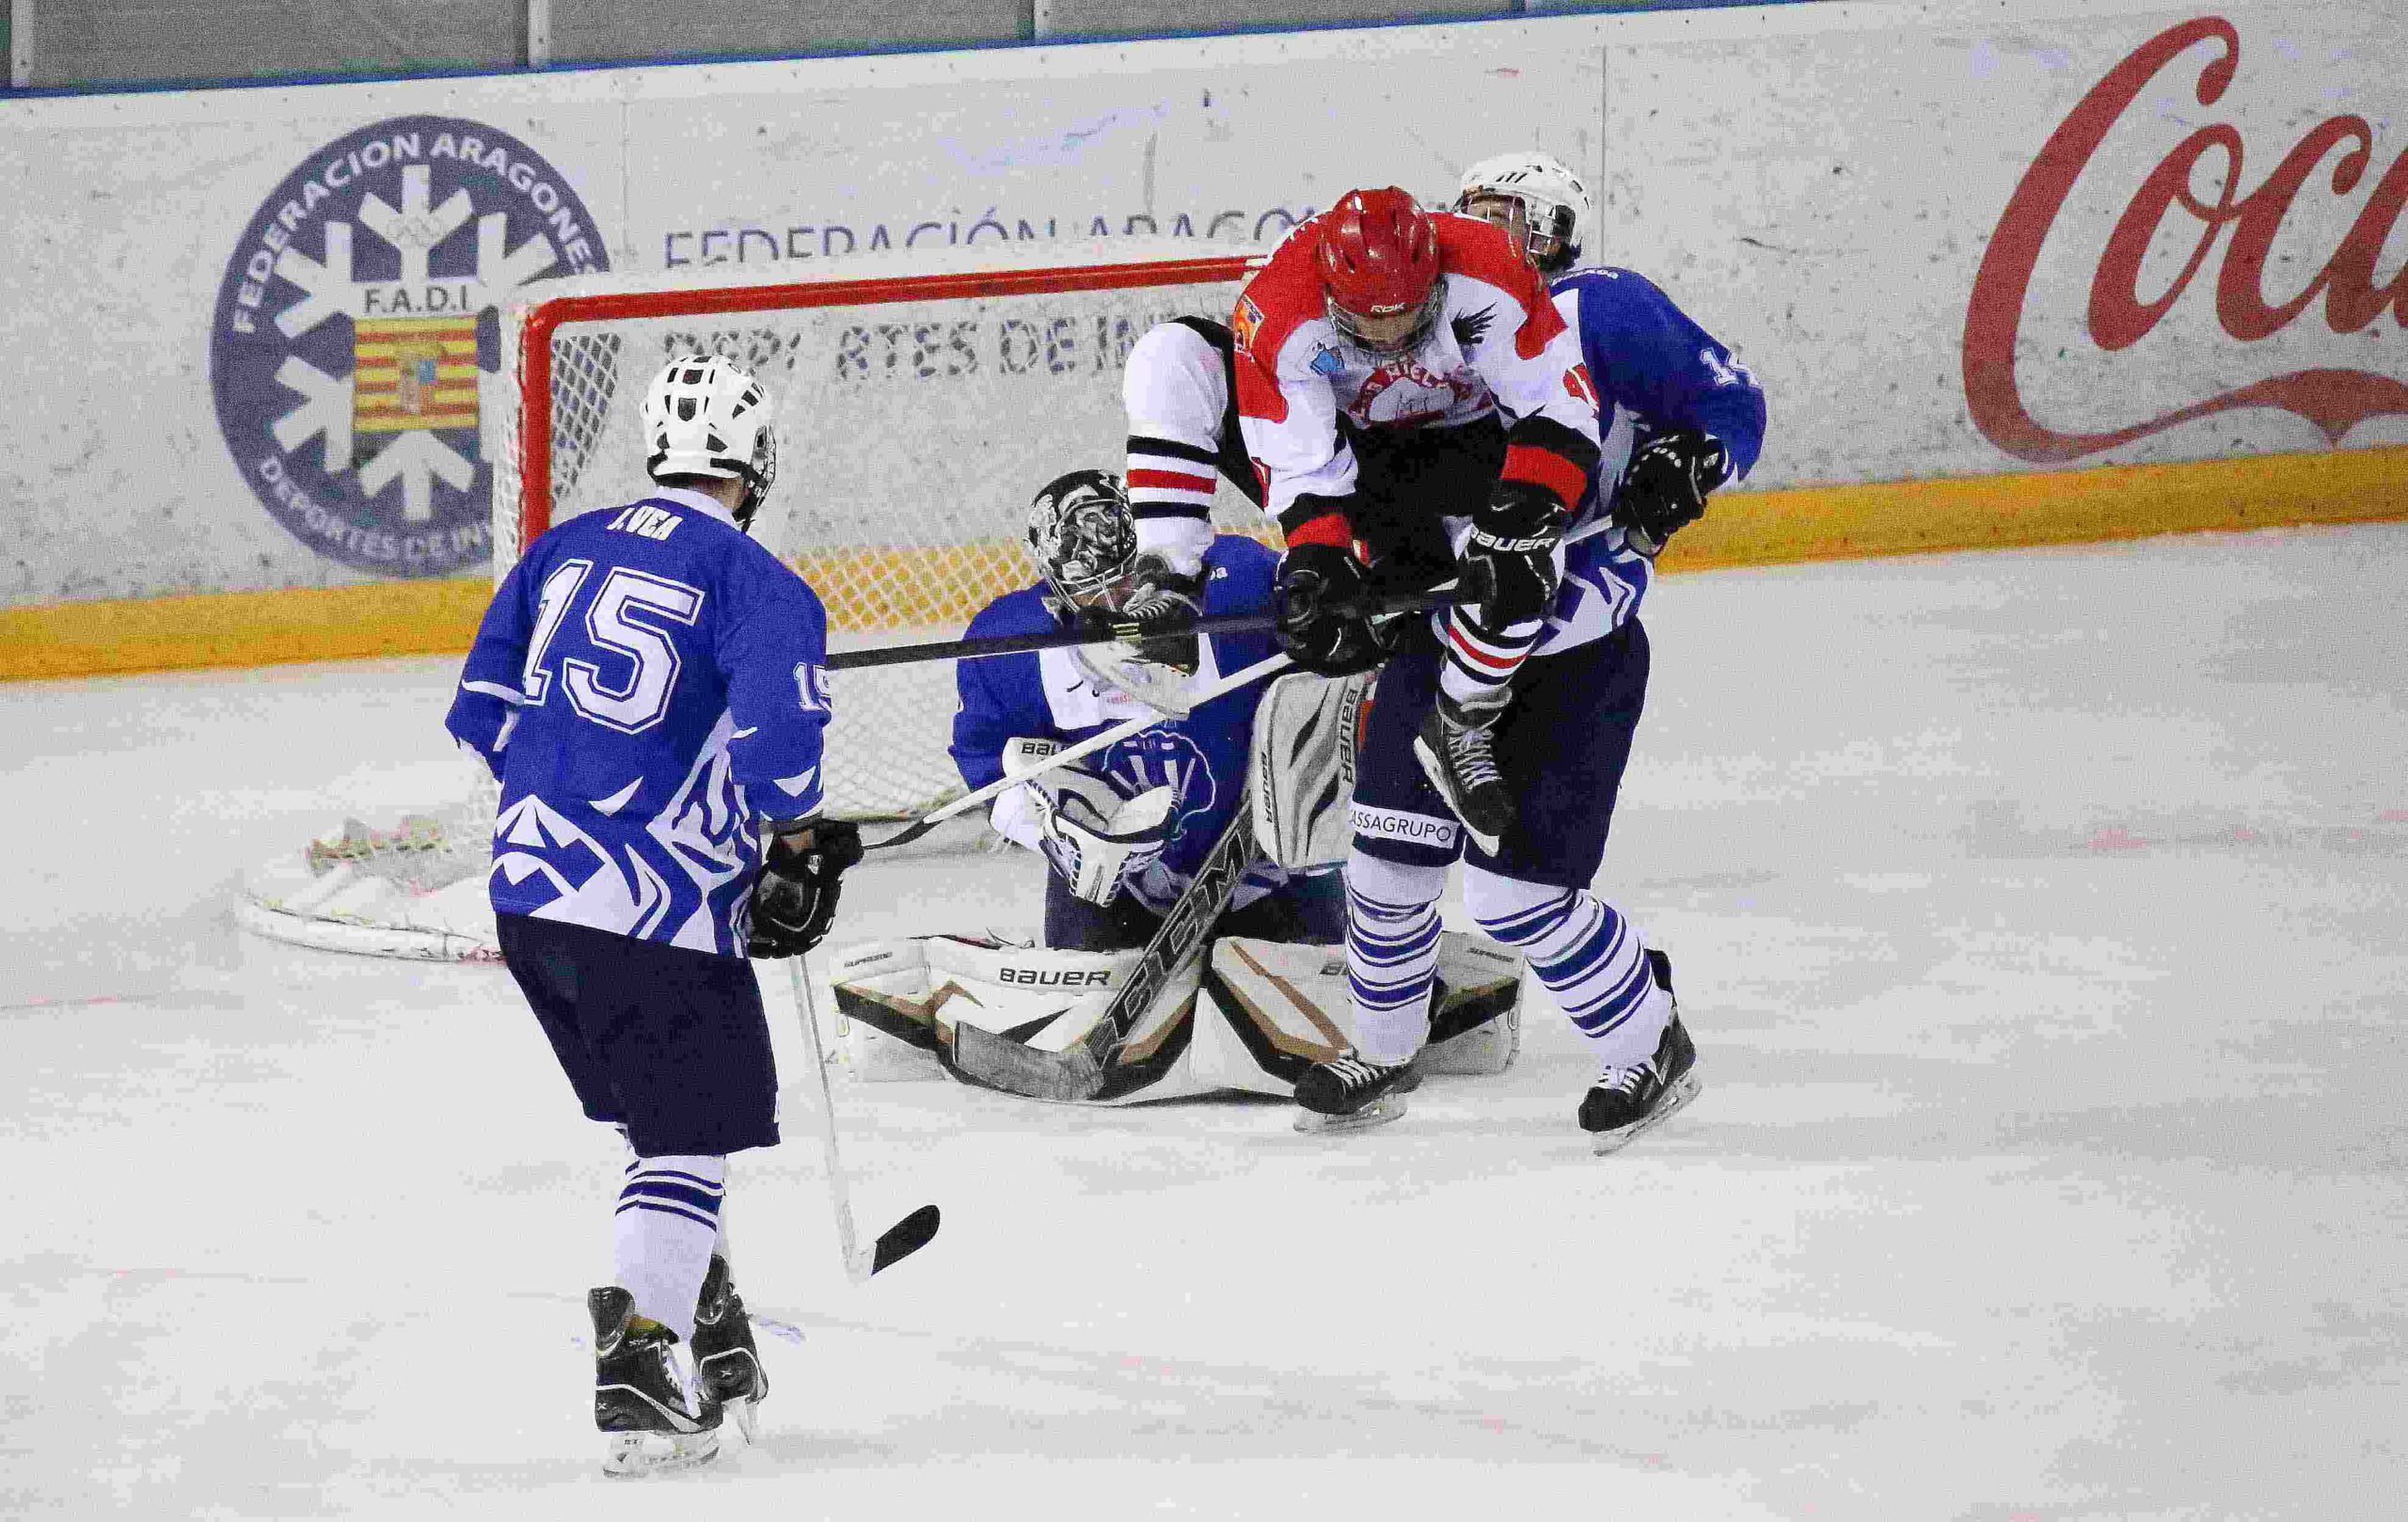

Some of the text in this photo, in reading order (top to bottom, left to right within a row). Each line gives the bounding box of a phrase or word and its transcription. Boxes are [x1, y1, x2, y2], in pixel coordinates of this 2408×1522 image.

[430, 133, 597, 274] ARAGONE
[522, 558, 705, 736] 15
[999, 967, 1111, 987] BAUER
